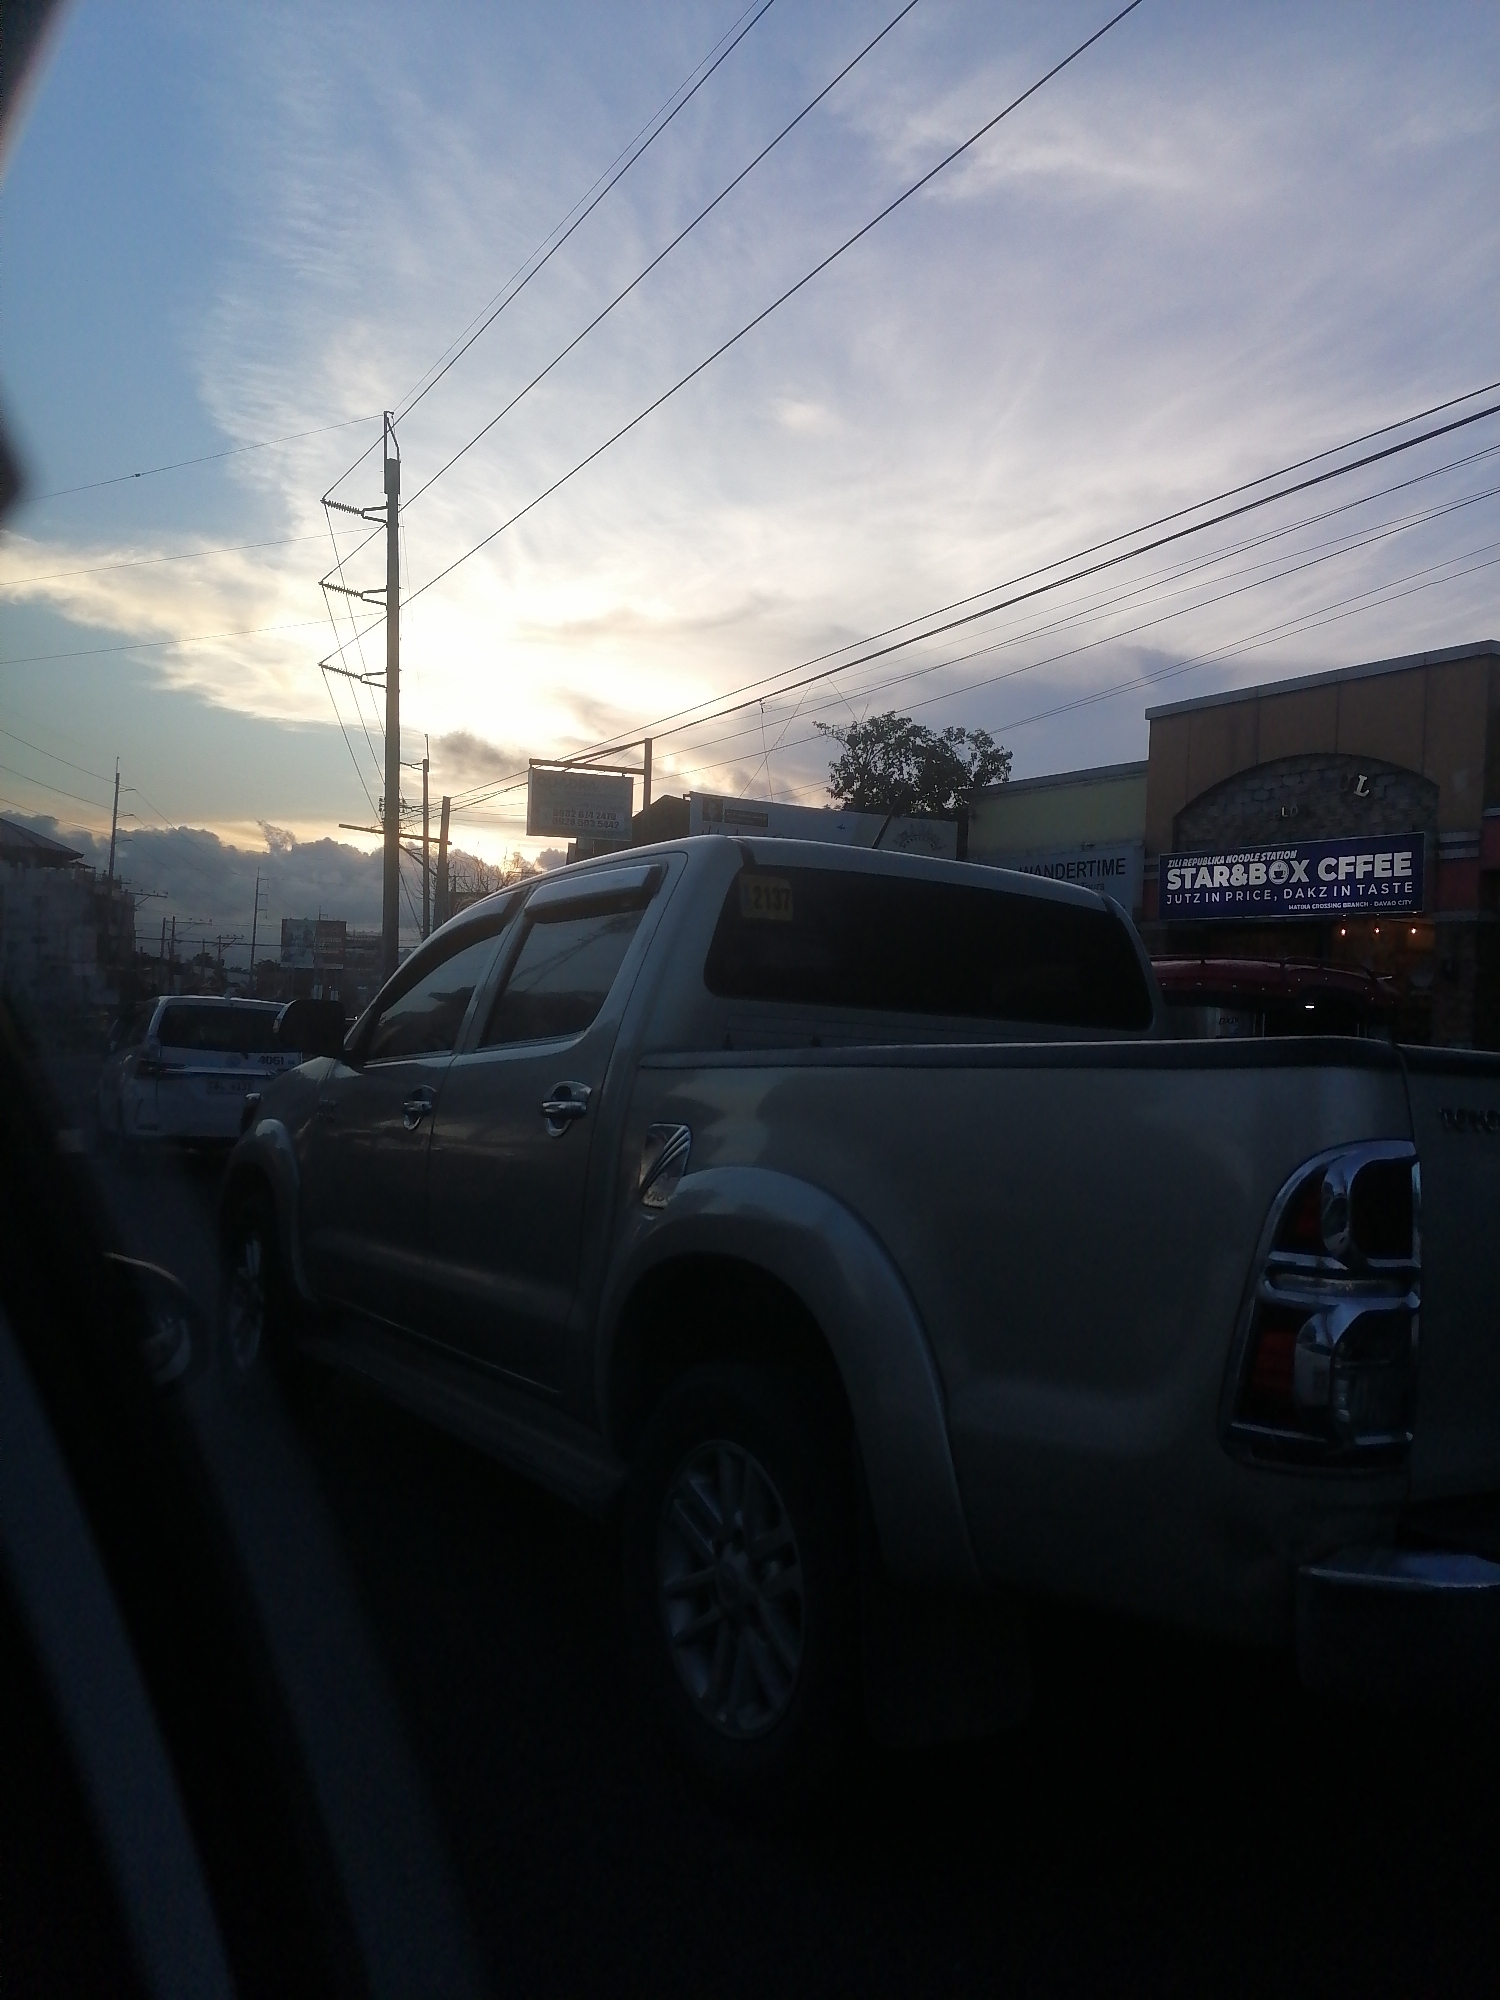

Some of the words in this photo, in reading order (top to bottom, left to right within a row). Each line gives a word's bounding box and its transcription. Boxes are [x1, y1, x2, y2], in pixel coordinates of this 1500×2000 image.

[1182, 855, 1225, 867] REPUBLIKA
[1226, 852, 1261, 864] NOODLE
[1260, 849, 1298, 861] STATION
[1317, 851, 1413, 881] CFFEE
[752, 885, 790, 912] 2137
[1166, 893, 1201, 905] JUTZ
[1205, 892, 1220, 903] IN
[1225, 889, 1278, 902] PRICE,
[1283, 886, 1328, 899] DAKZ
[1333, 884, 1351, 897] IN
[1356, 881, 1413, 896] TASTE
